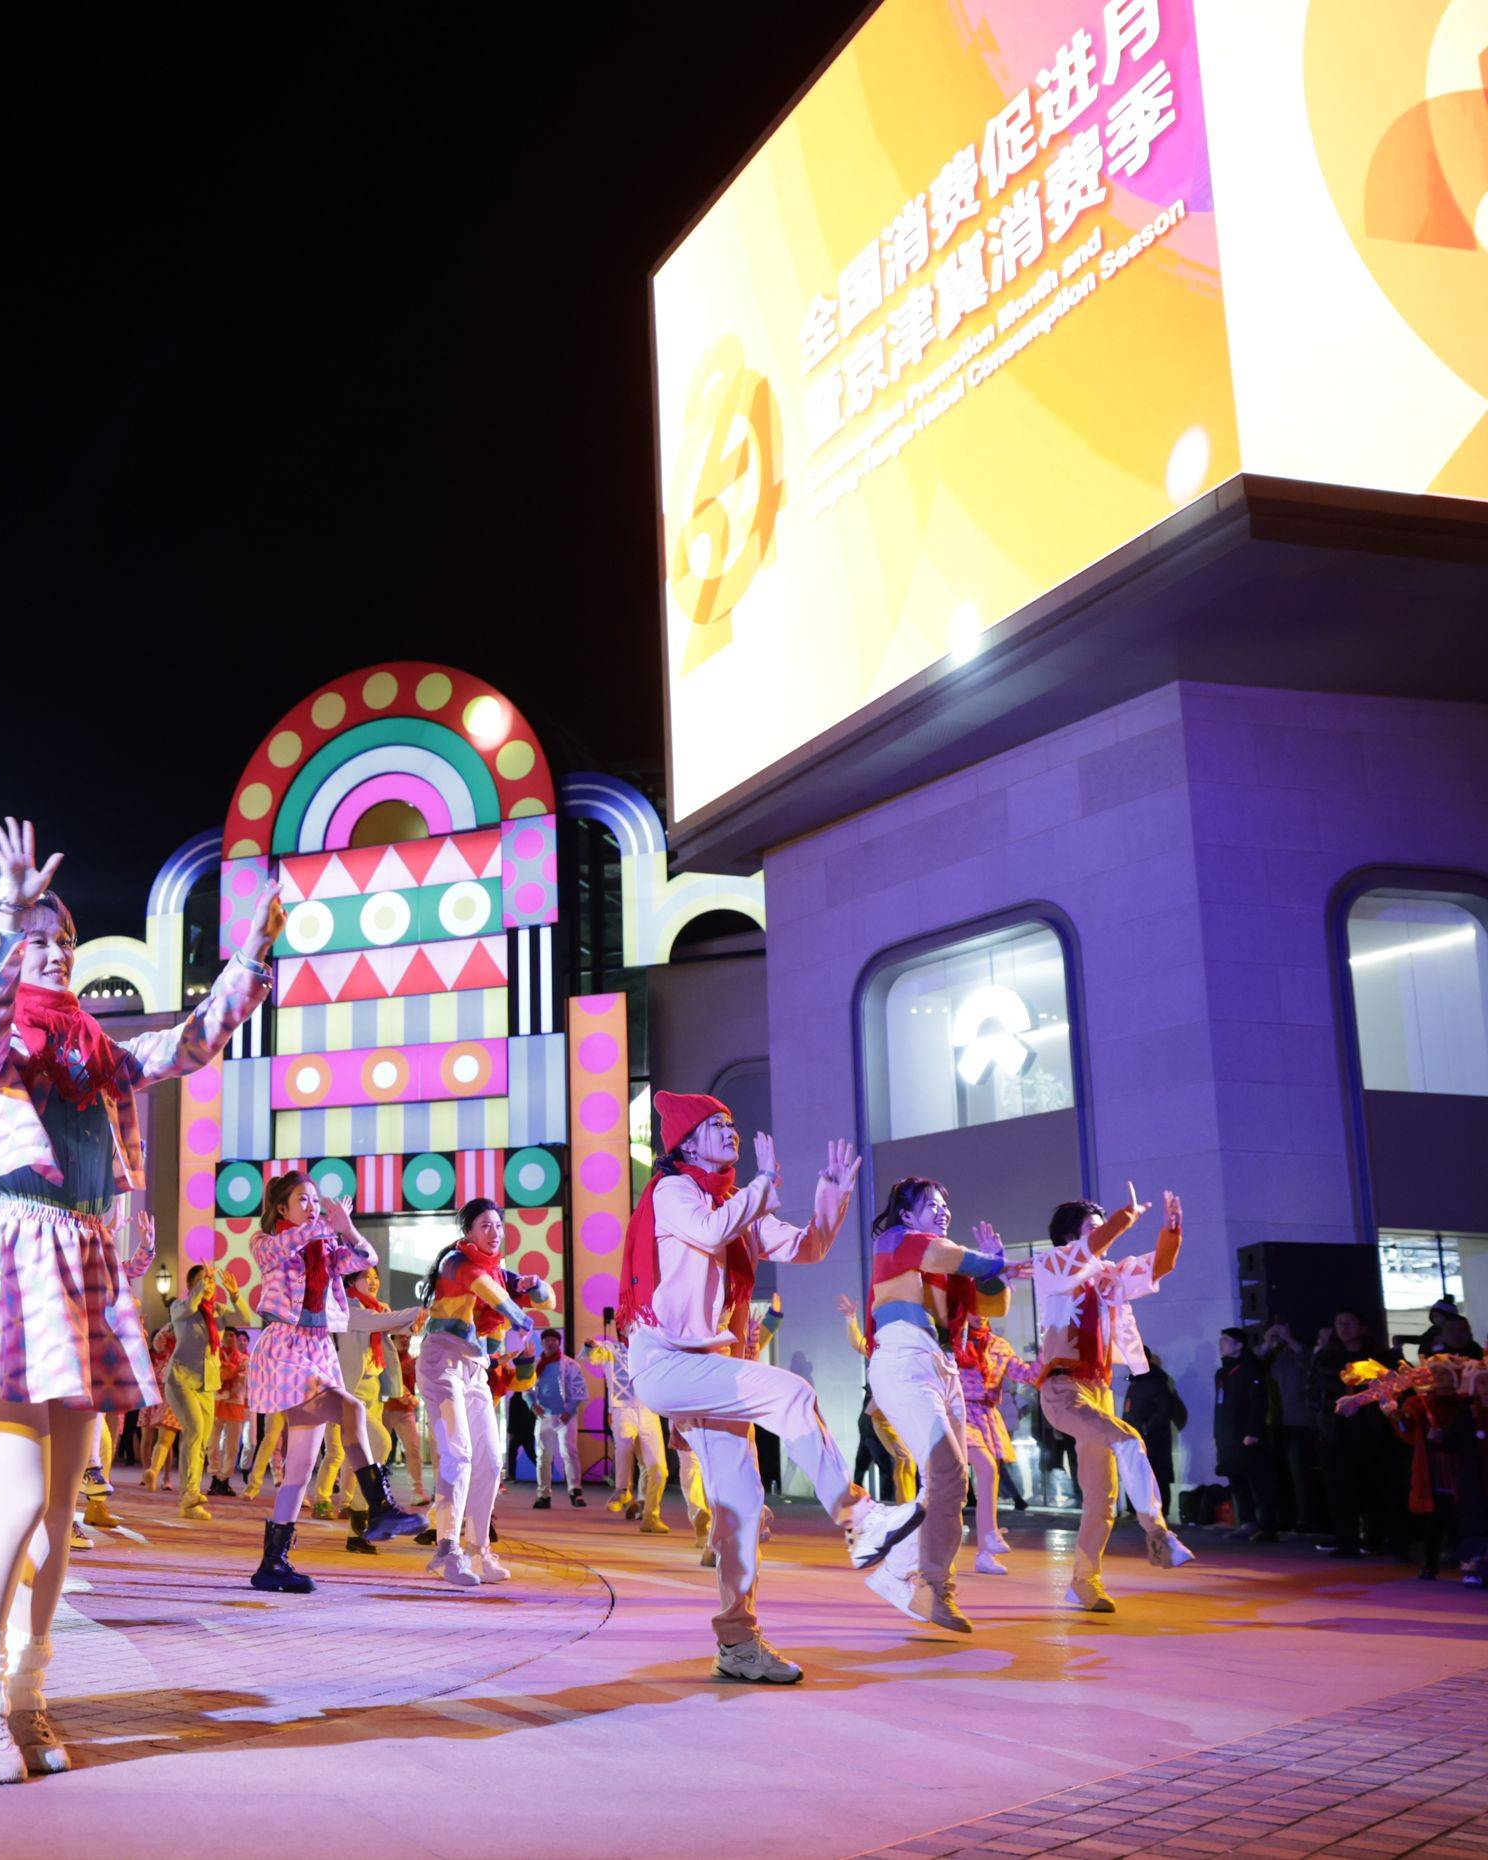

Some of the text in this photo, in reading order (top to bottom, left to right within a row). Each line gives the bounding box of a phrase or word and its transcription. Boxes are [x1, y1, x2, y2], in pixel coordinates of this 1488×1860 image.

[798, 0, 1160, 374] 全国消费促进月
[997, 269, 1059, 333] Month
[1061, 226, 1102, 278] and
[967, 199, 1186, 387] Consumption Season
